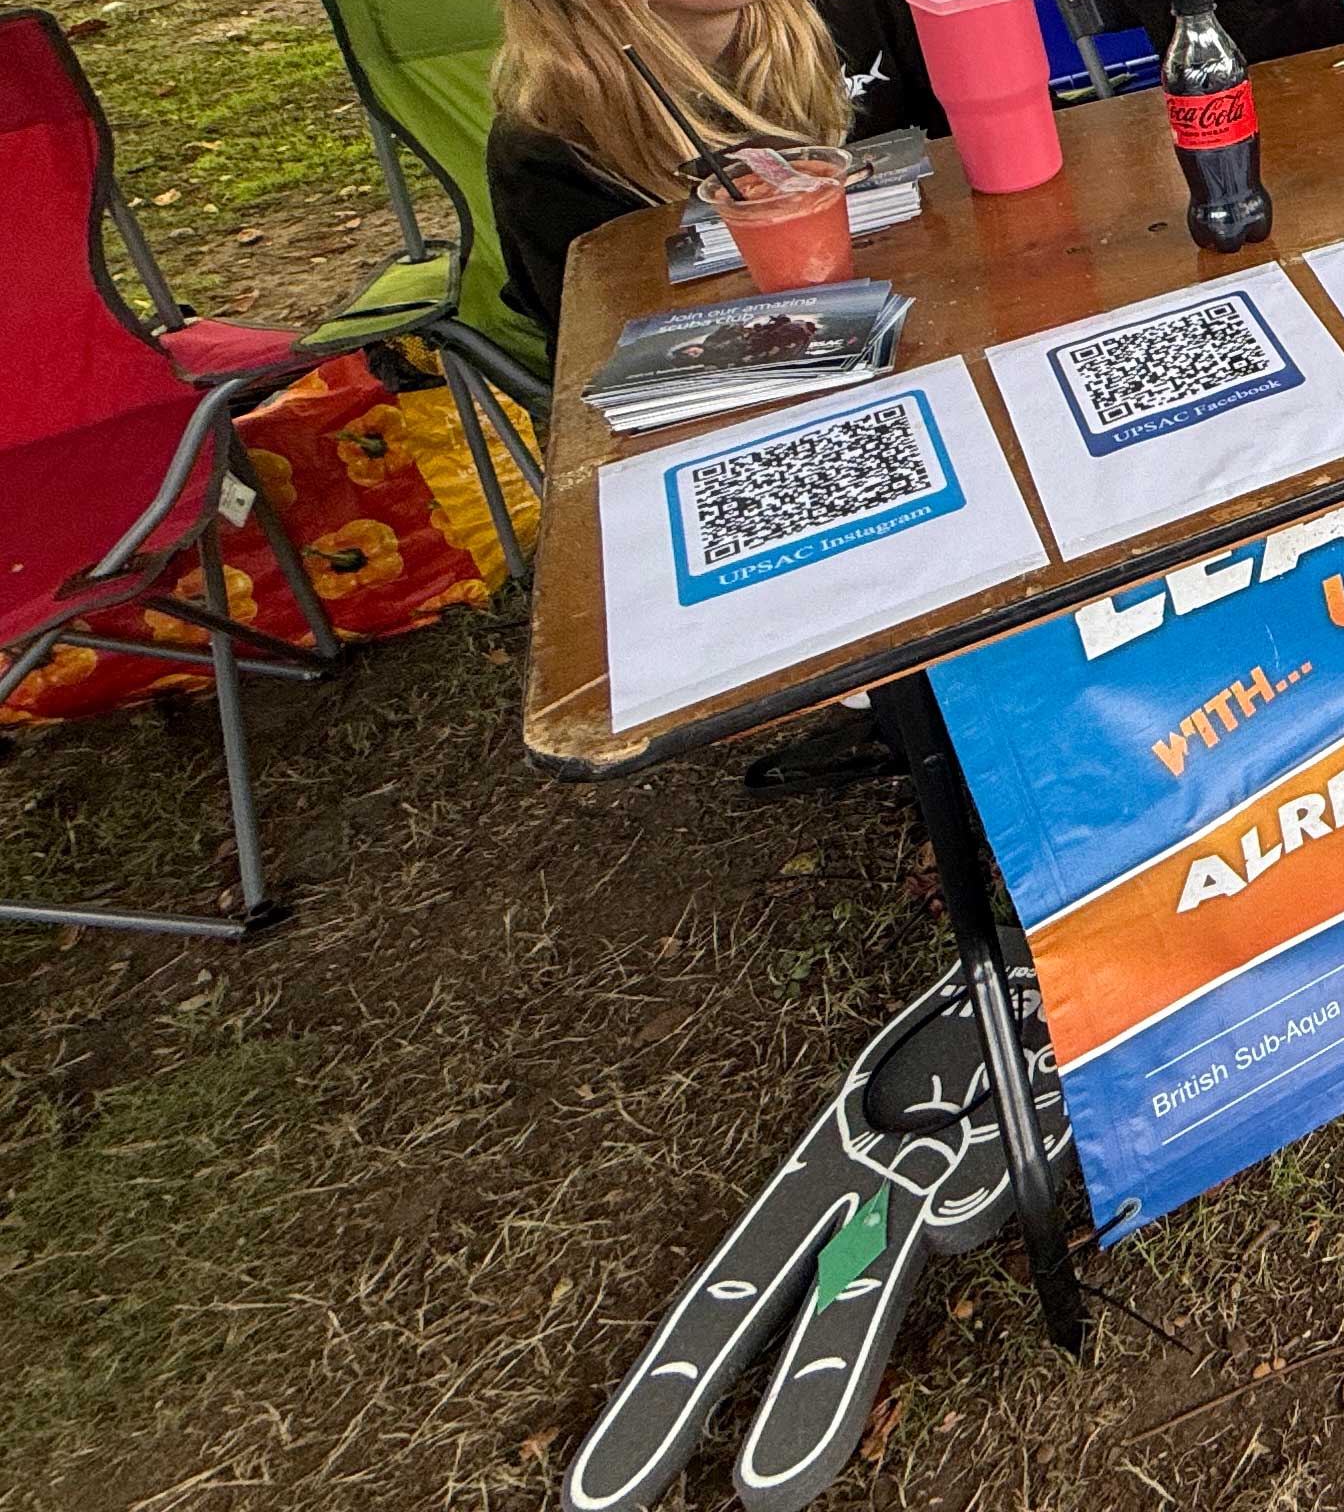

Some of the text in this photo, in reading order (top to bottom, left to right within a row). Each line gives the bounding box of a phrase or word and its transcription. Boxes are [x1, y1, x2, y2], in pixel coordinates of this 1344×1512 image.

[656, 312, 755, 334] scuba club
[664, 297, 818, 324] Join our amazing
[1113, 378, 1283, 444] UPSAC Facebook
[718, 503, 934, 587] UPSAC Instagram
[1151, 661, 1313, 777] WITH...
[1151, 1062, 1229, 1119] British
[1234, 998, 1341, 1074] Sub-Aqua
